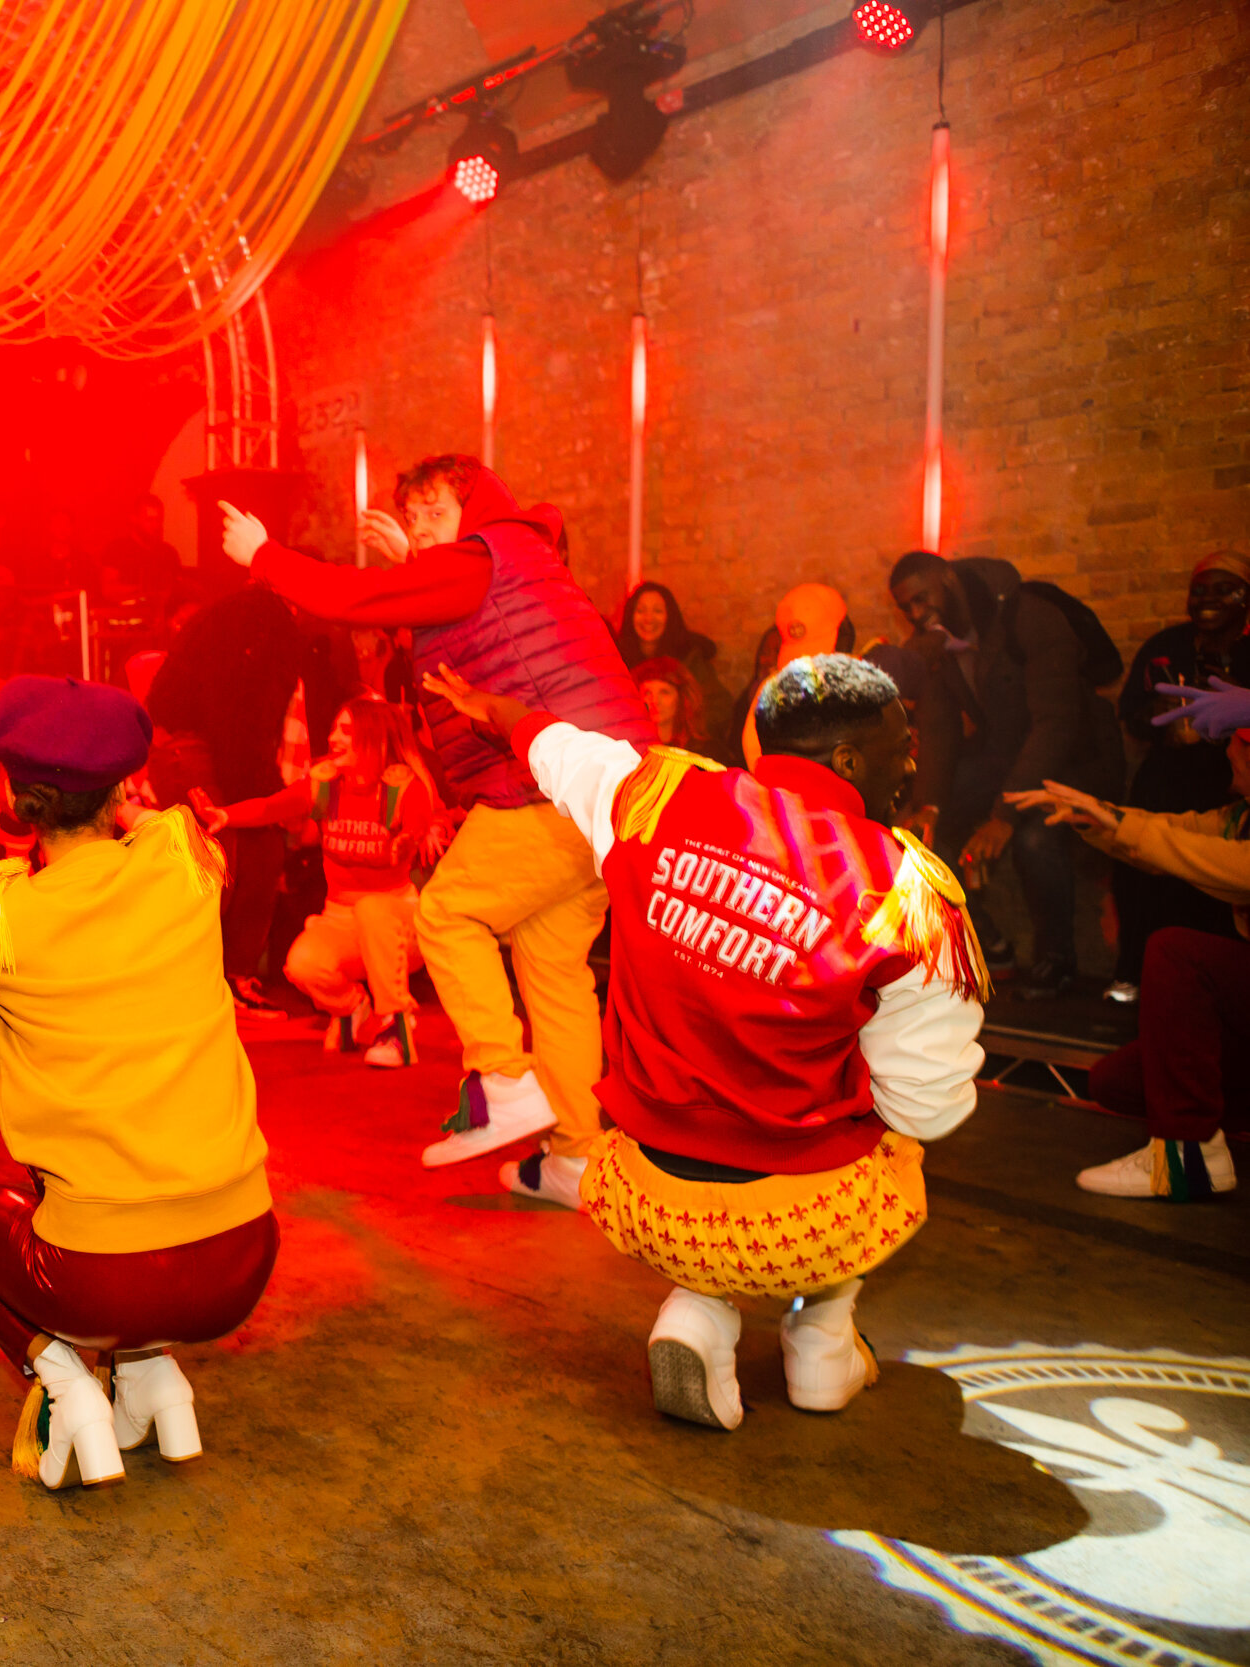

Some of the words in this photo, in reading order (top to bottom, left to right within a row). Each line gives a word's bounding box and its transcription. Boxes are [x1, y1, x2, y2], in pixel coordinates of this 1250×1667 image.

[651, 847, 832, 953] SOUTHERN
[685, 838, 702, 849] THE
[703, 844, 730, 857] SPIRIT
[732, 853, 746, 862] OF
[748, 860, 770, 875] NEW
[771, 870, 818, 900] ORLEANS
[646, 889, 798, 986] COMFORT
[697, 960, 724, 979] 1874
